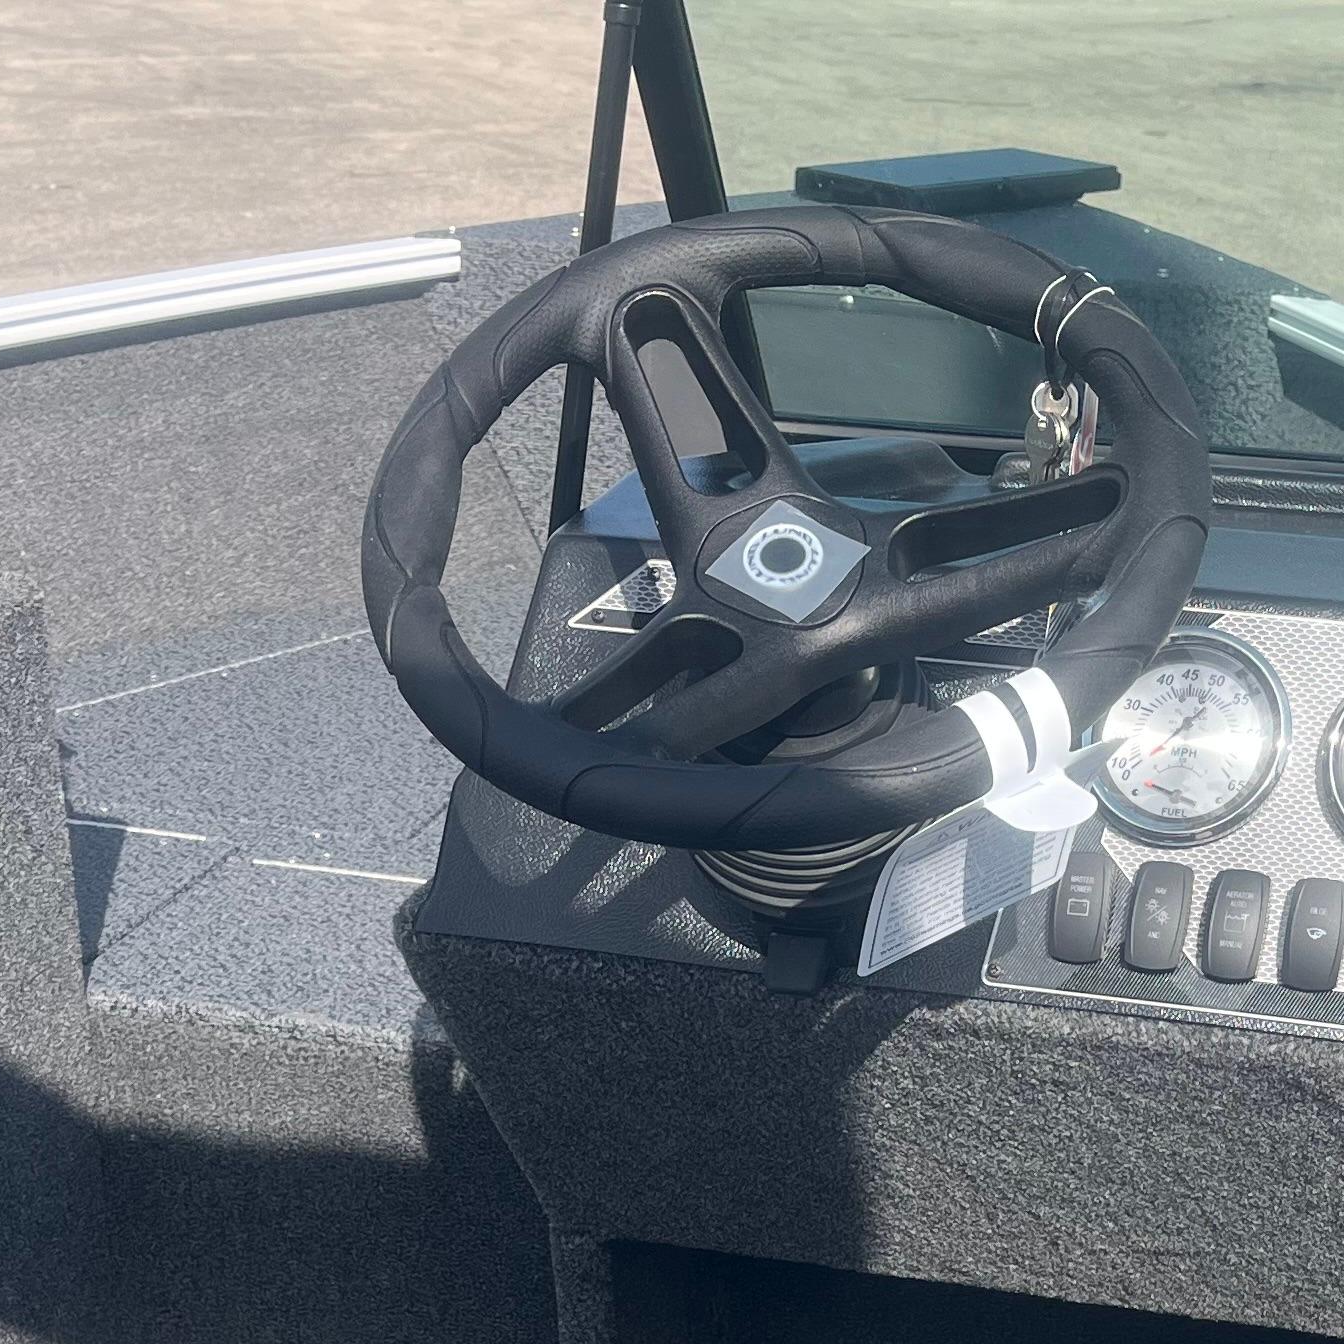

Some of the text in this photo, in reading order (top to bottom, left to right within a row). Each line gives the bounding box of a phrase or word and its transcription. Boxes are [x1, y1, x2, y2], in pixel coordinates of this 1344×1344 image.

[1156, 673, 1175, 686] 40
[1181, 668, 1200, 681] 45
[1208, 674, 1226, 687] 50
[1124, 698, 1141, 711] 30
[1232, 692, 1250, 706] 55
[1170, 746, 1199, 758] MPH
[1111, 757, 1127, 768] 10
[1122, 769, 1131, 781] 0
[1227, 779, 1246, 792] 65
[1161, 807, 1188, 818] FUEL
[1071, 885, 1092, 893] POWER
